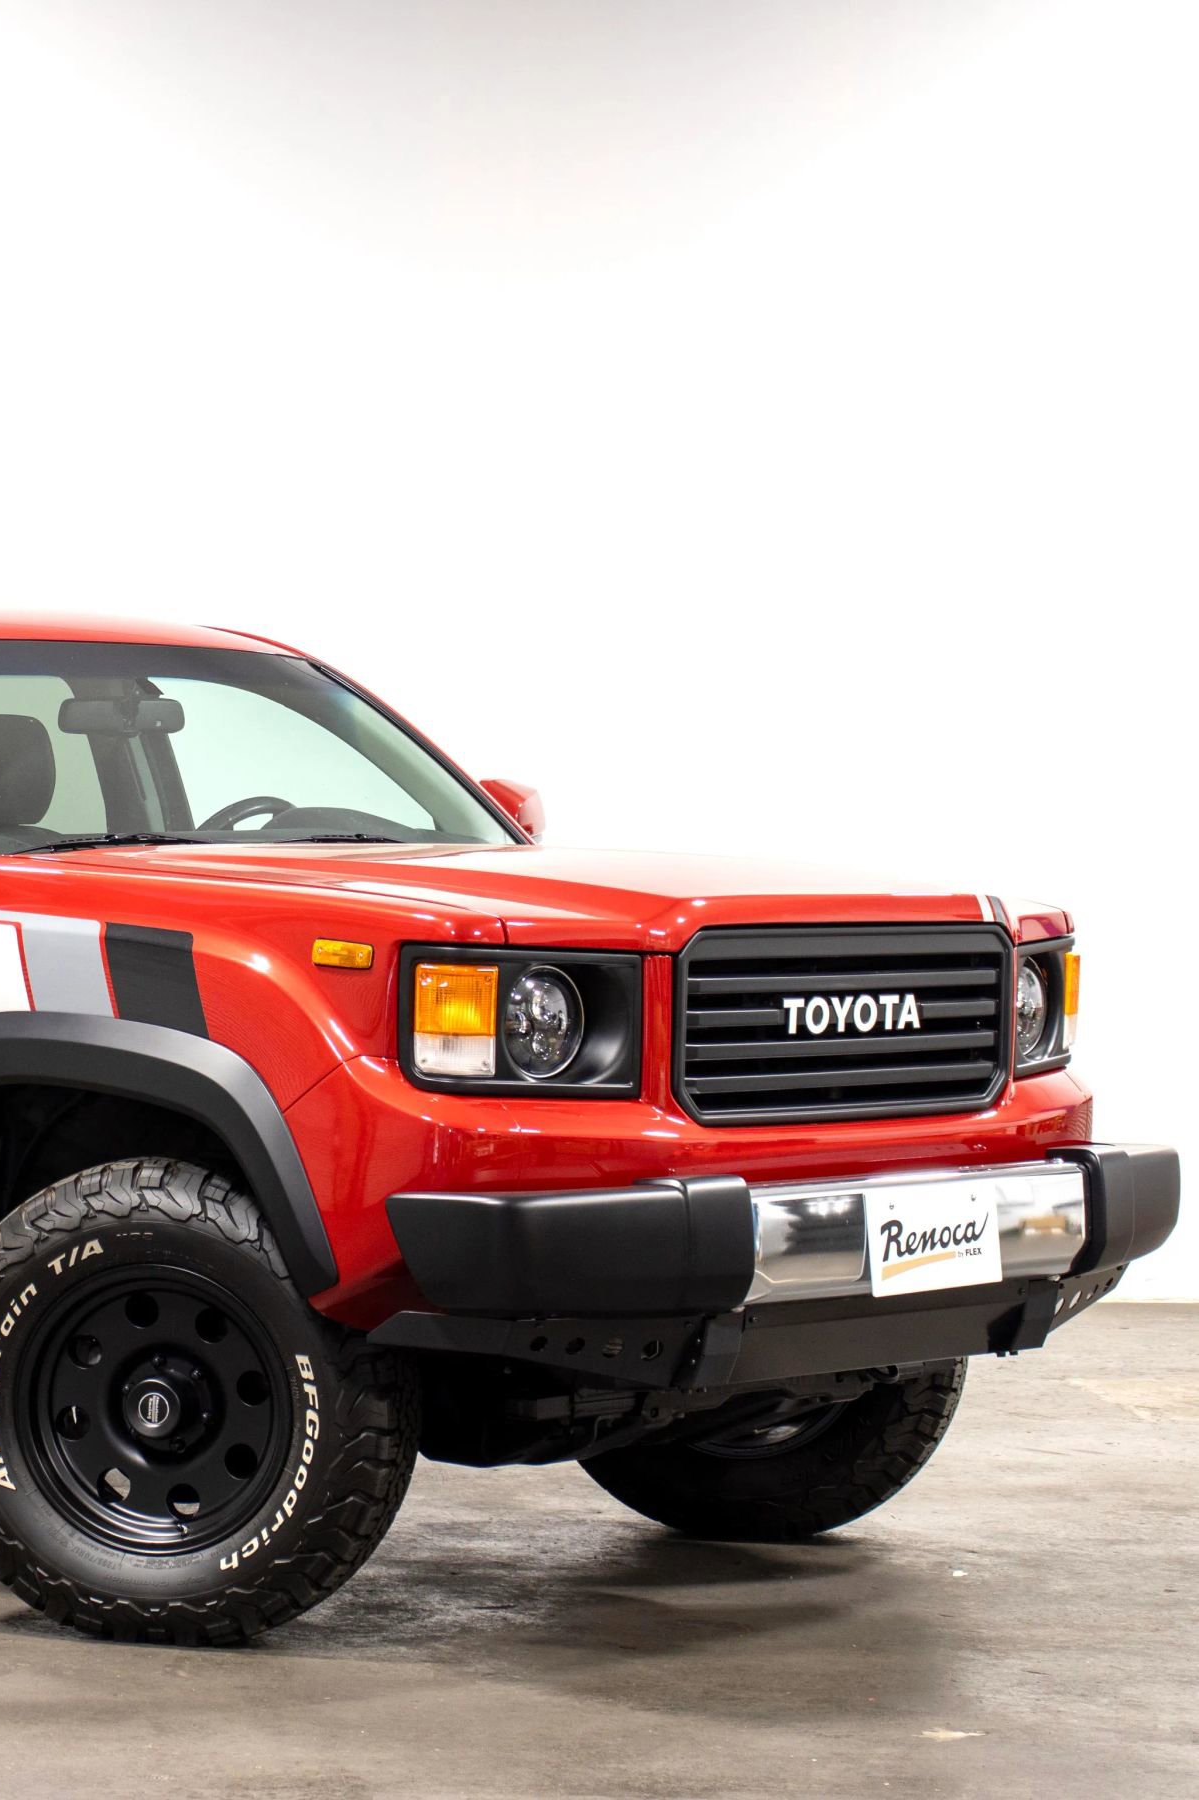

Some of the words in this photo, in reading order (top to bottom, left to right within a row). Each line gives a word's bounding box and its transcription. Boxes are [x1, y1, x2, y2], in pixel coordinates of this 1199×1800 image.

[783, 993, 921, 1035] TOYOTA
[47, 1239, 104, 1276] T/A
[880, 1211, 989, 1262] Renoca
[965, 1247, 982, 1256] FLEX
[219, 1354, 320, 1571] BFGoodrich
